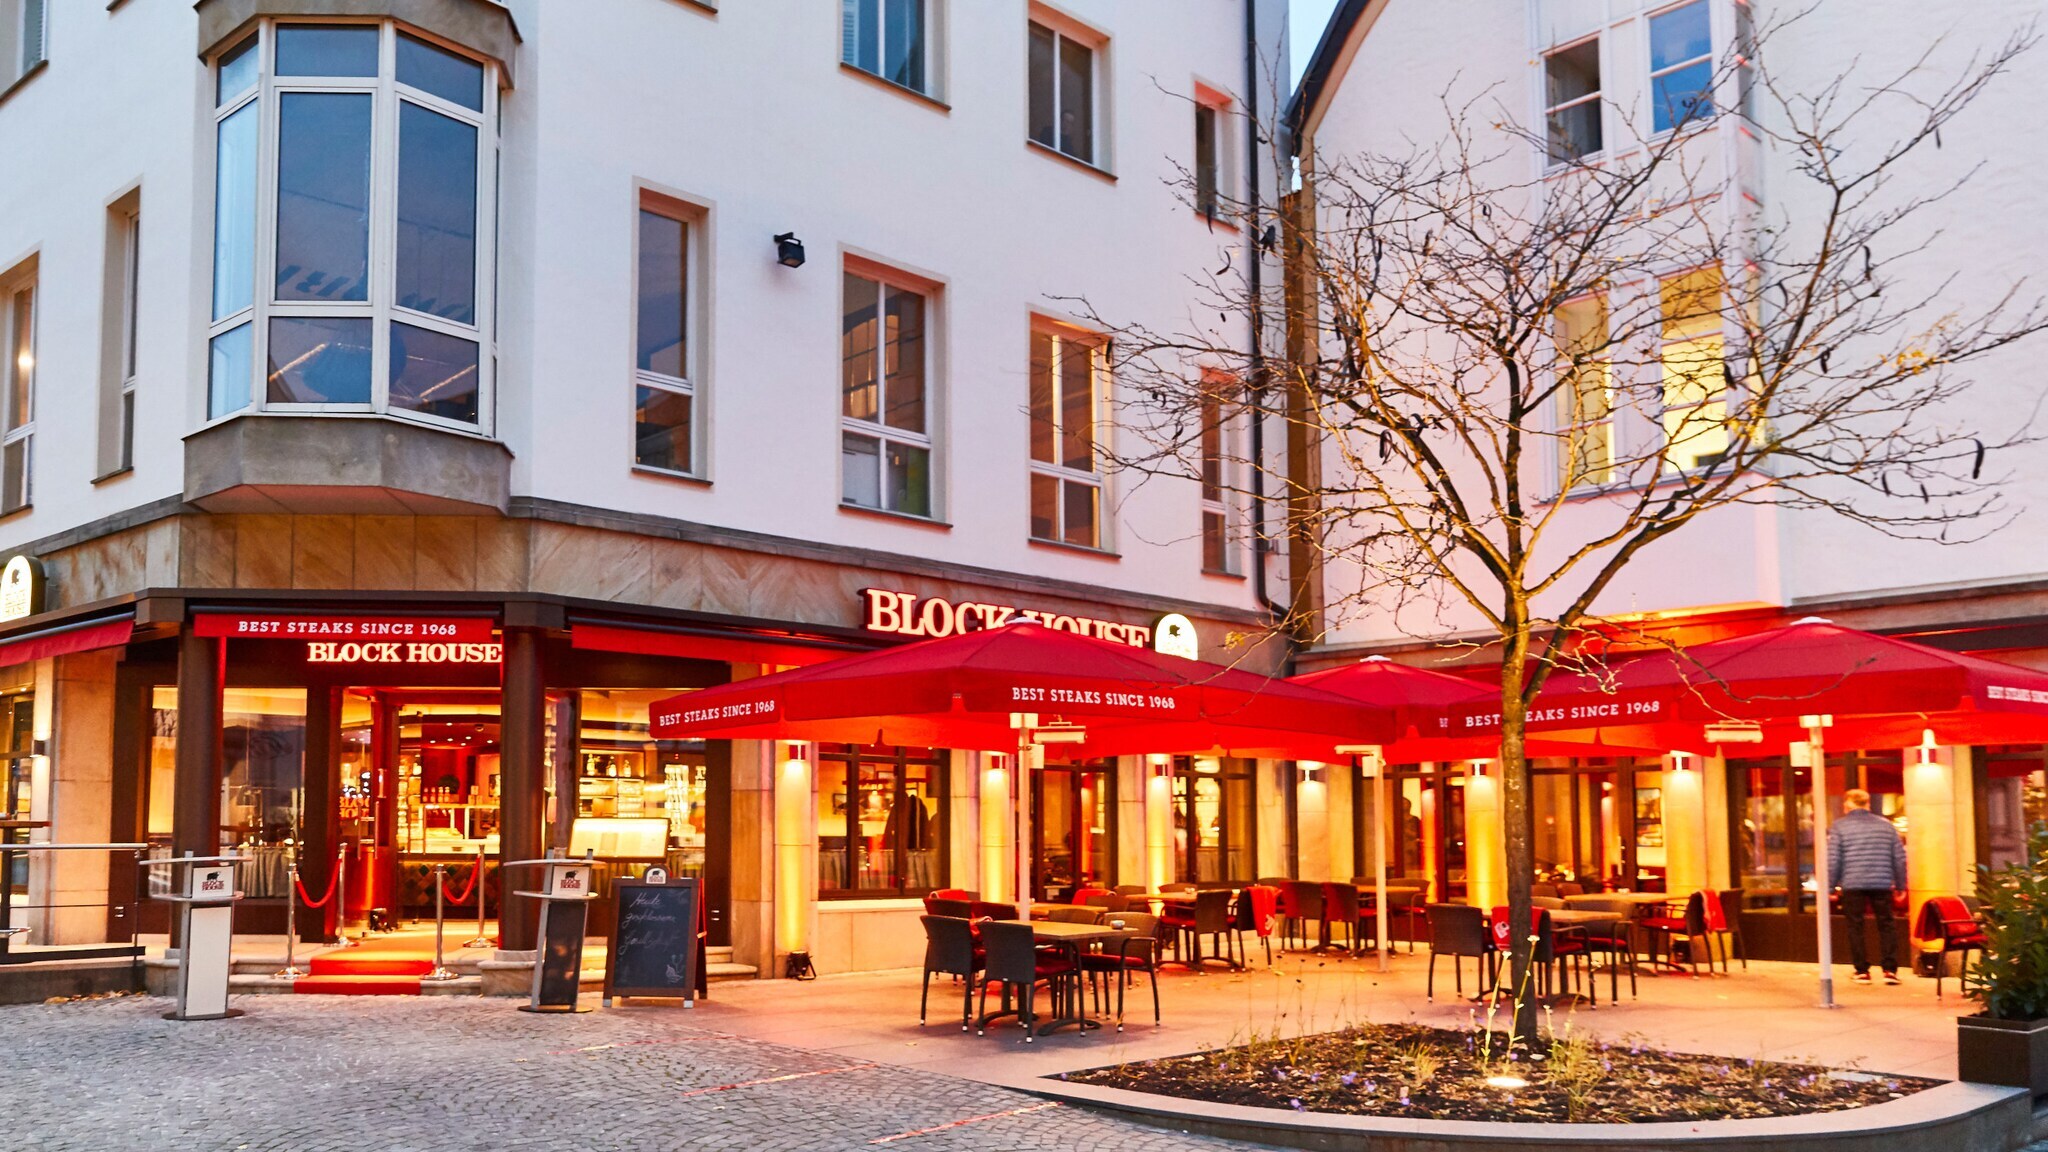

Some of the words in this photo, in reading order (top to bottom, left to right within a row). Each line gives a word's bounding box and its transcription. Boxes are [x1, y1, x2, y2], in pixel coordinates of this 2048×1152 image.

[238, 621, 281, 633] BEST
[287, 622, 354, 634] STEAKS
[361, 623, 414, 635] SINCE
[421, 624, 457, 636] 1968
[306, 642, 403, 663] BLOCK
[406, 643, 502, 664] HOUSE
[1012, 687, 1046, 701] BEST
[1050, 689, 1101, 704] STEAKS
[1106, 692, 1145, 707] SINCE
[1149, 696, 1176, 709] 1968
[659, 713, 682, 727] BEST
[684, 707, 720, 723] STEAKS
[722, 703, 752, 718] SINCE
[754, 700, 775, 714] 1968
[1465, 713, 1501, 727] BEST
[1571, 704, 1620, 718] SINCE
[1626, 700, 1660, 715] 1968
